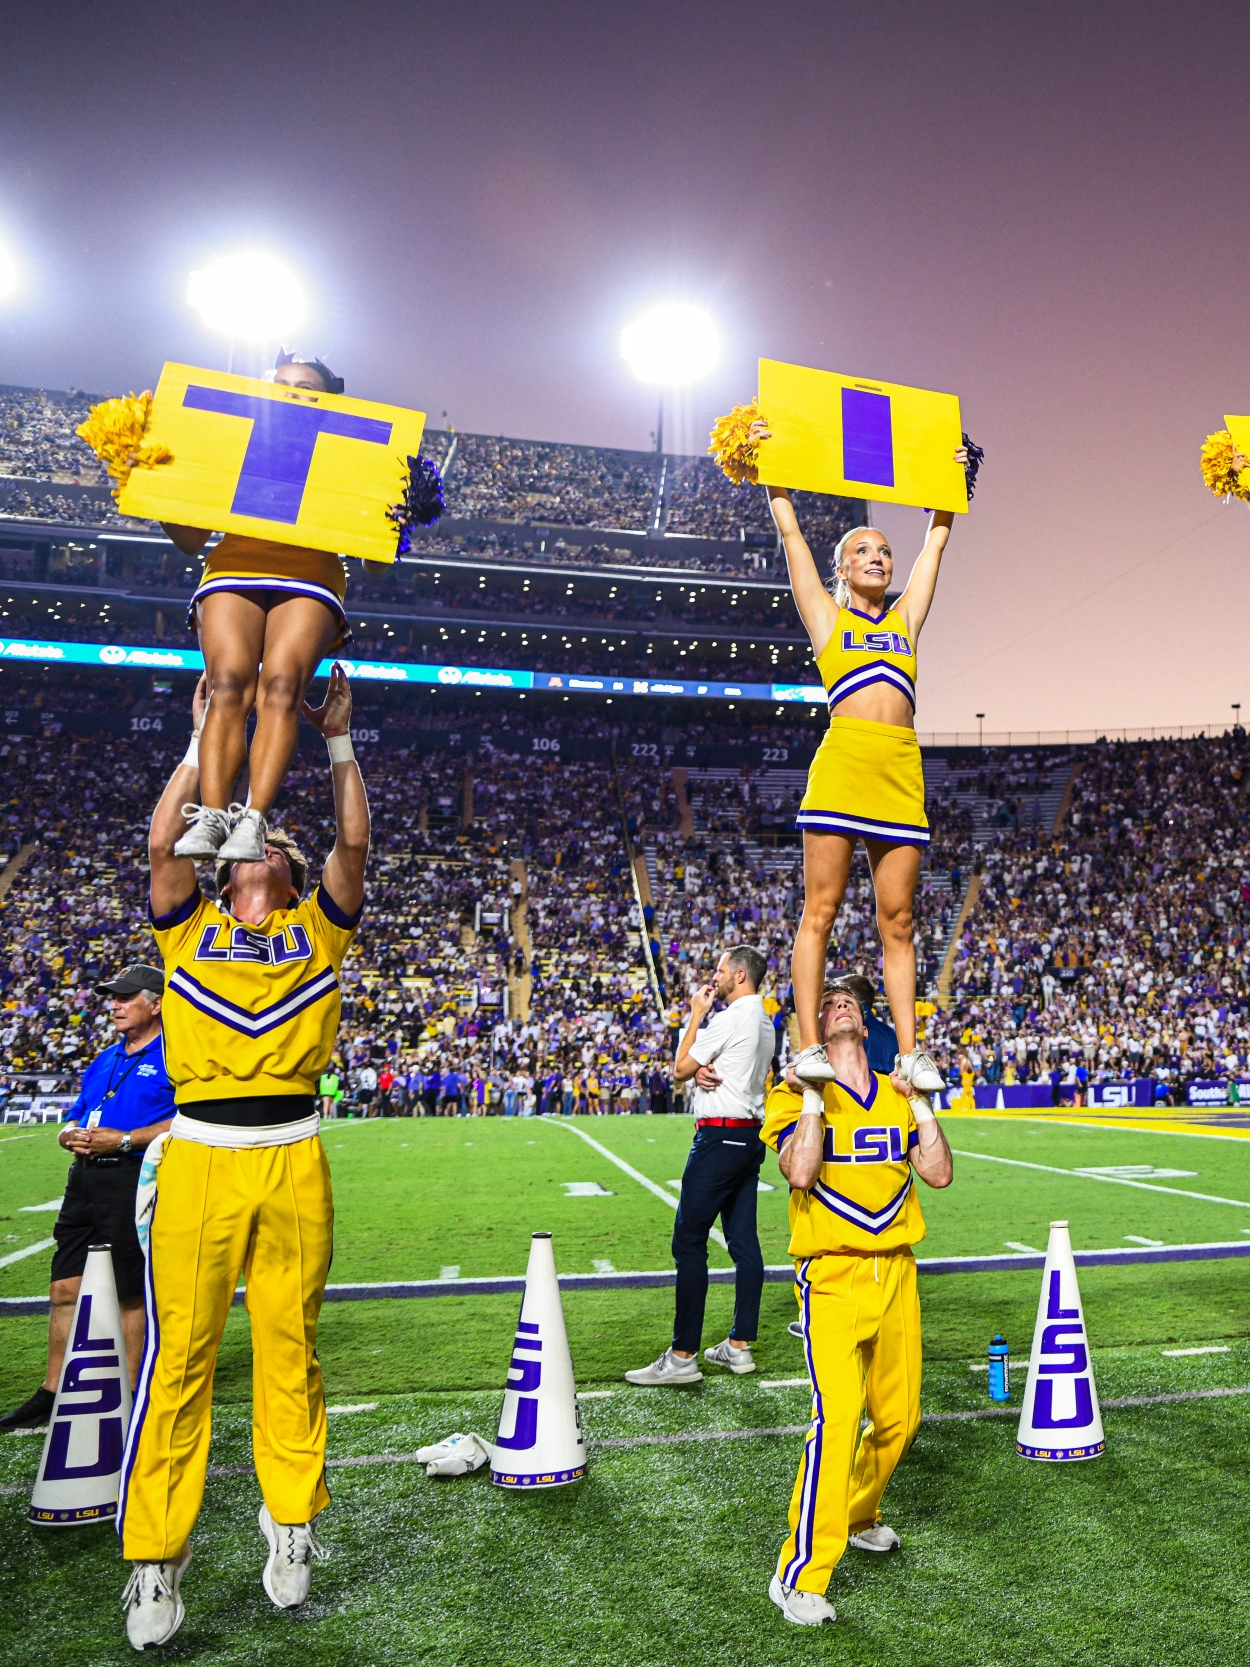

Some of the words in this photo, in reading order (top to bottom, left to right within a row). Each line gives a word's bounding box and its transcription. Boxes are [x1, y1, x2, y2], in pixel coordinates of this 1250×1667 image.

[841, 387, 894, 487] I
[182, 384, 394, 525] T
[842, 630, 913, 657] LSU
[130, 718, 163, 731] 104
[350, 729, 380, 742] 105
[532, 738, 561, 751] 106
[631, 744, 657, 756] 222
[762, 748, 788, 761] 223
[194, 924, 313, 966] LSU
[1088, 1086, 1136, 1107] LSU
[1032, 1270, 1094, 1429] LSU
[43, 1295, 123, 1481] LSU
[1035, 1450, 1051, 1458] LSU
[1069, 1449, 1085, 1457] LSU
[501, 1475, 517, 1484] LSU
[536, 1474, 555, 1483] LSU
[37, 1511, 54, 1520] LSU
[76, 1509, 99, 1518] LSU
